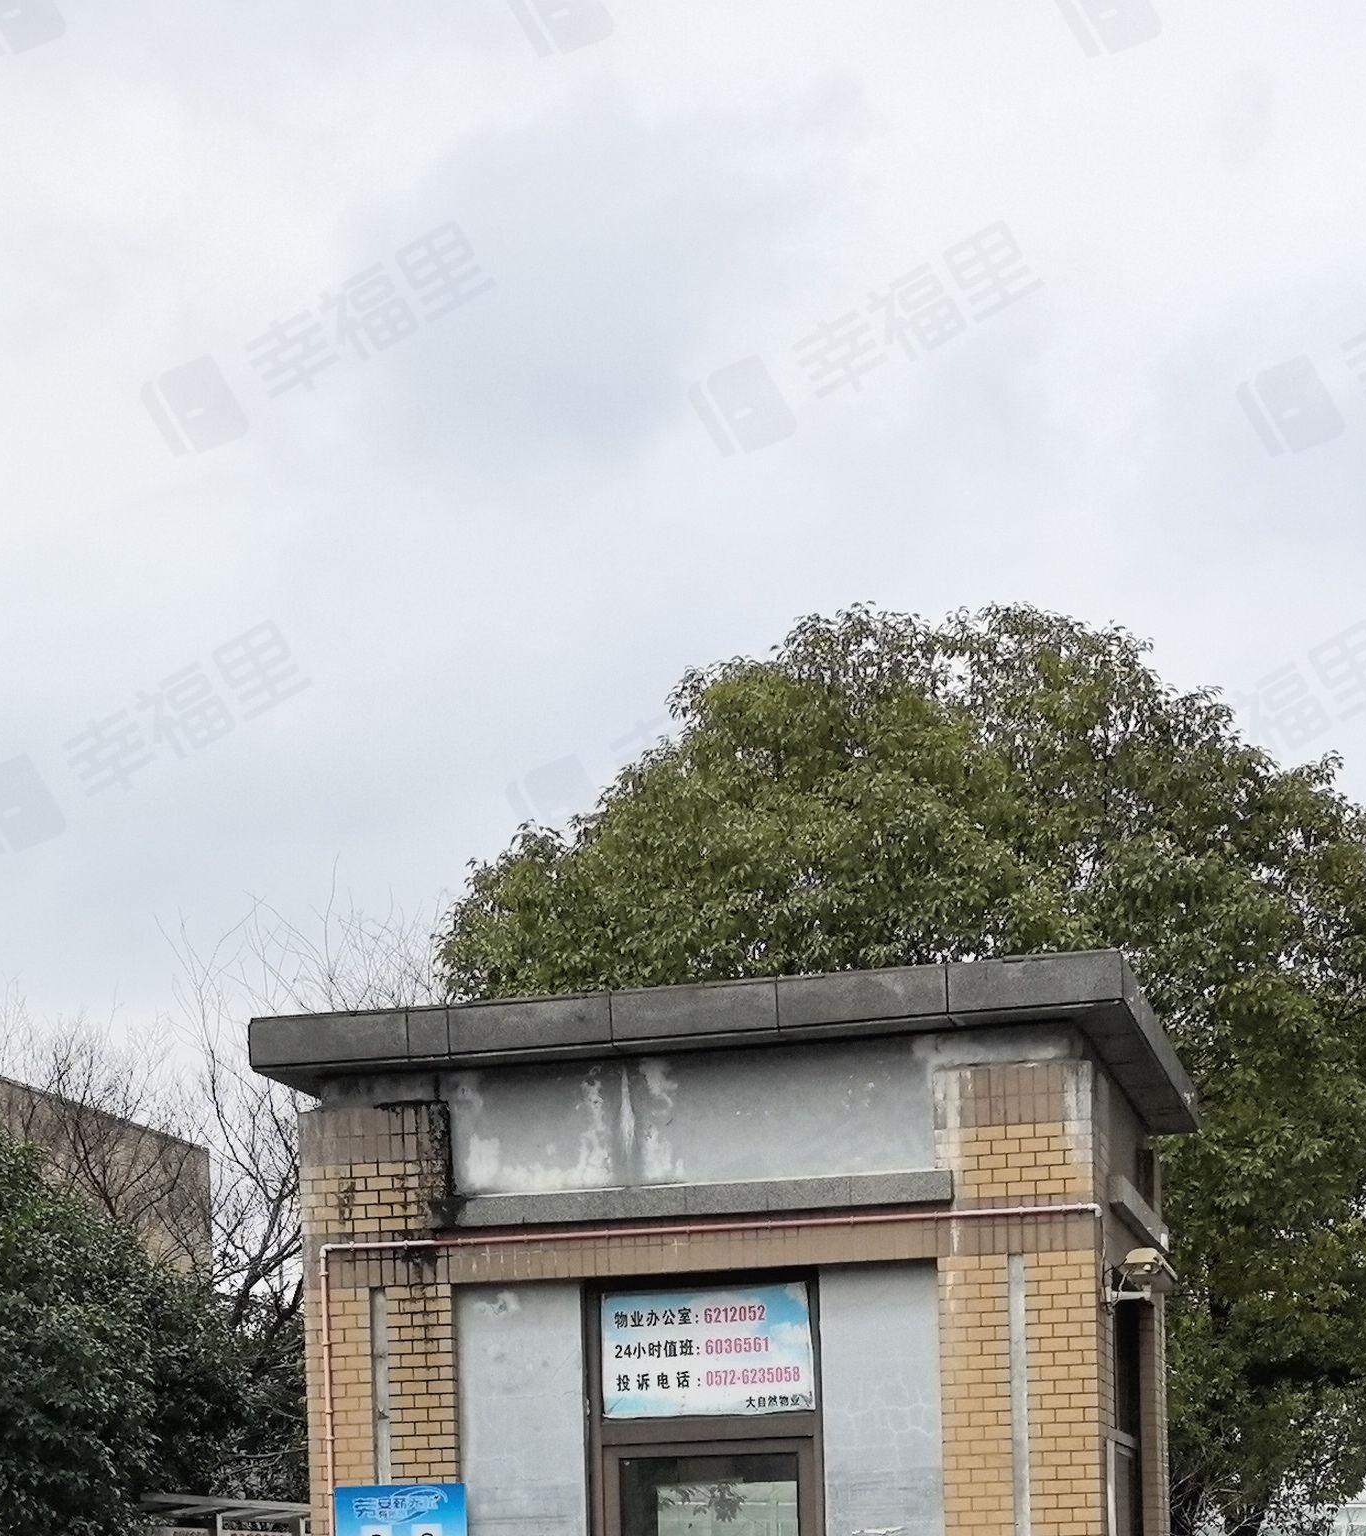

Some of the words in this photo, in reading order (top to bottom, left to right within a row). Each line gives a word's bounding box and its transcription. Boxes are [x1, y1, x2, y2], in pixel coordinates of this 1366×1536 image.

[745, 1395, 800, 1409] 大自然物业
